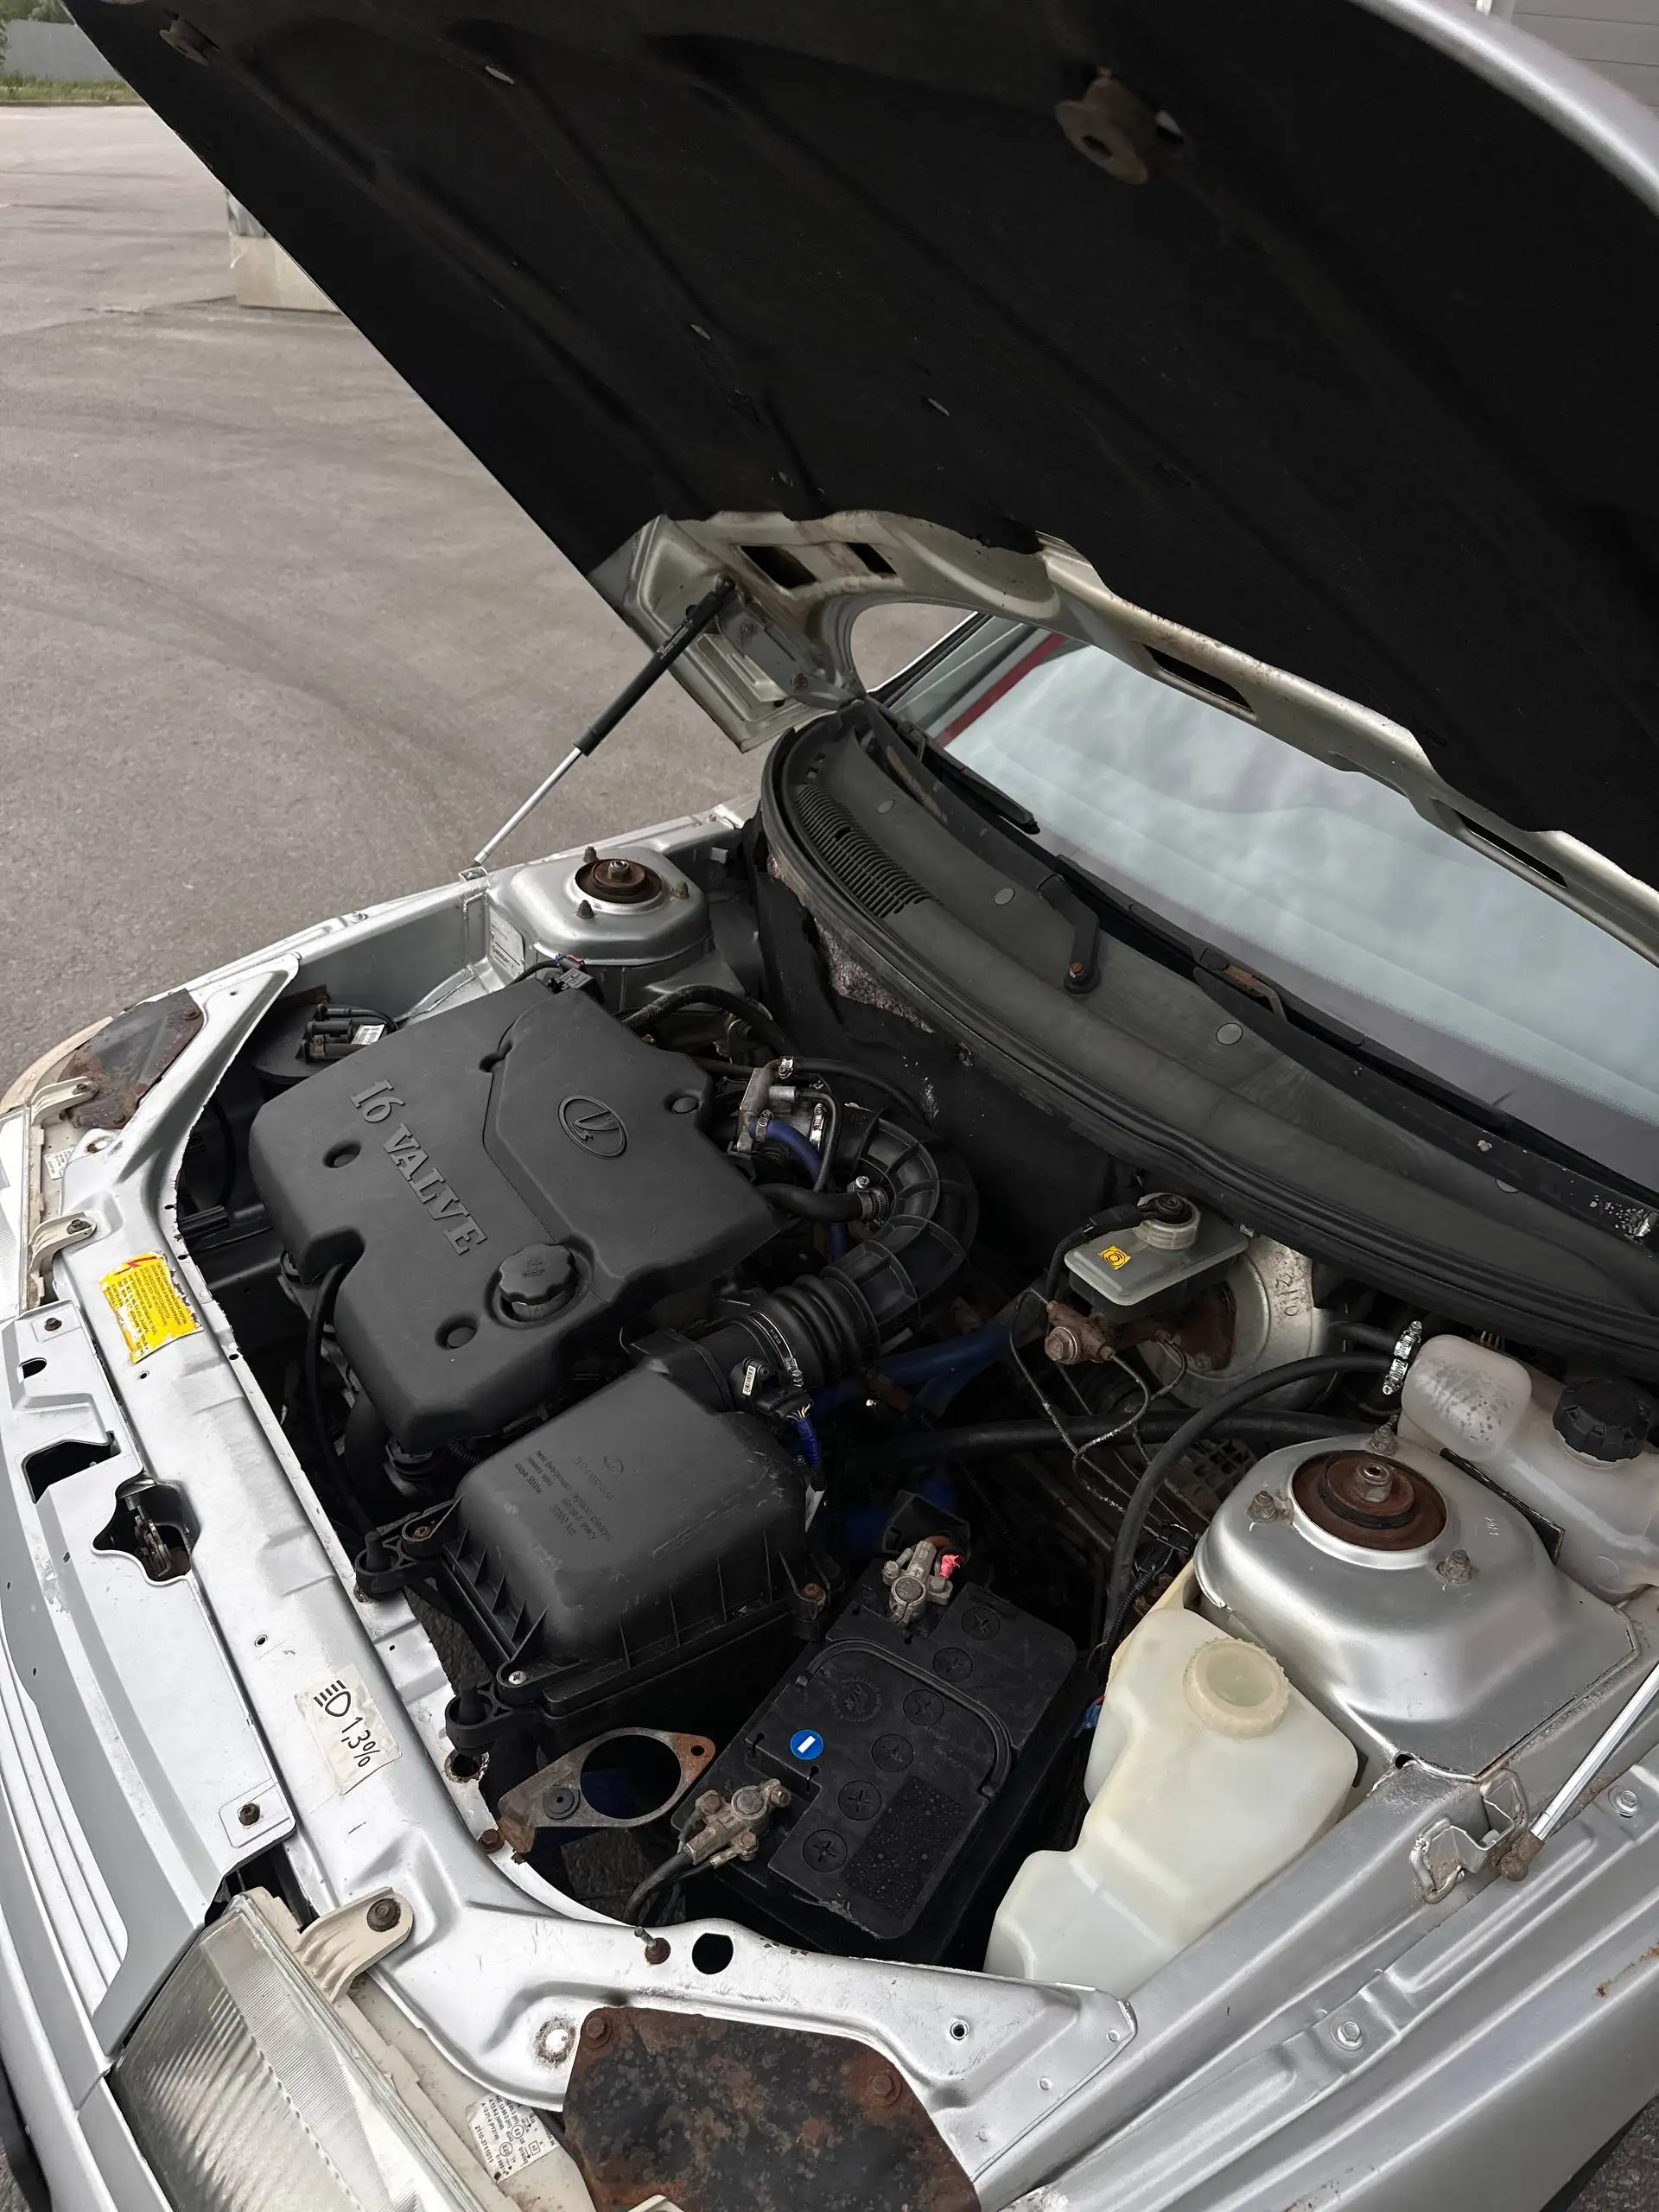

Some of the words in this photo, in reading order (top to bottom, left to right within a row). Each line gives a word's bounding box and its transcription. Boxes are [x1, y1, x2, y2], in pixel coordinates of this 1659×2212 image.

[350, 1079, 406, 1123] 16
[383, 1122, 487, 1255] VALVE
[341, 1717, 381, 1768] 1,3%
[474, 2125, 494, 2164] 2110-3711011
